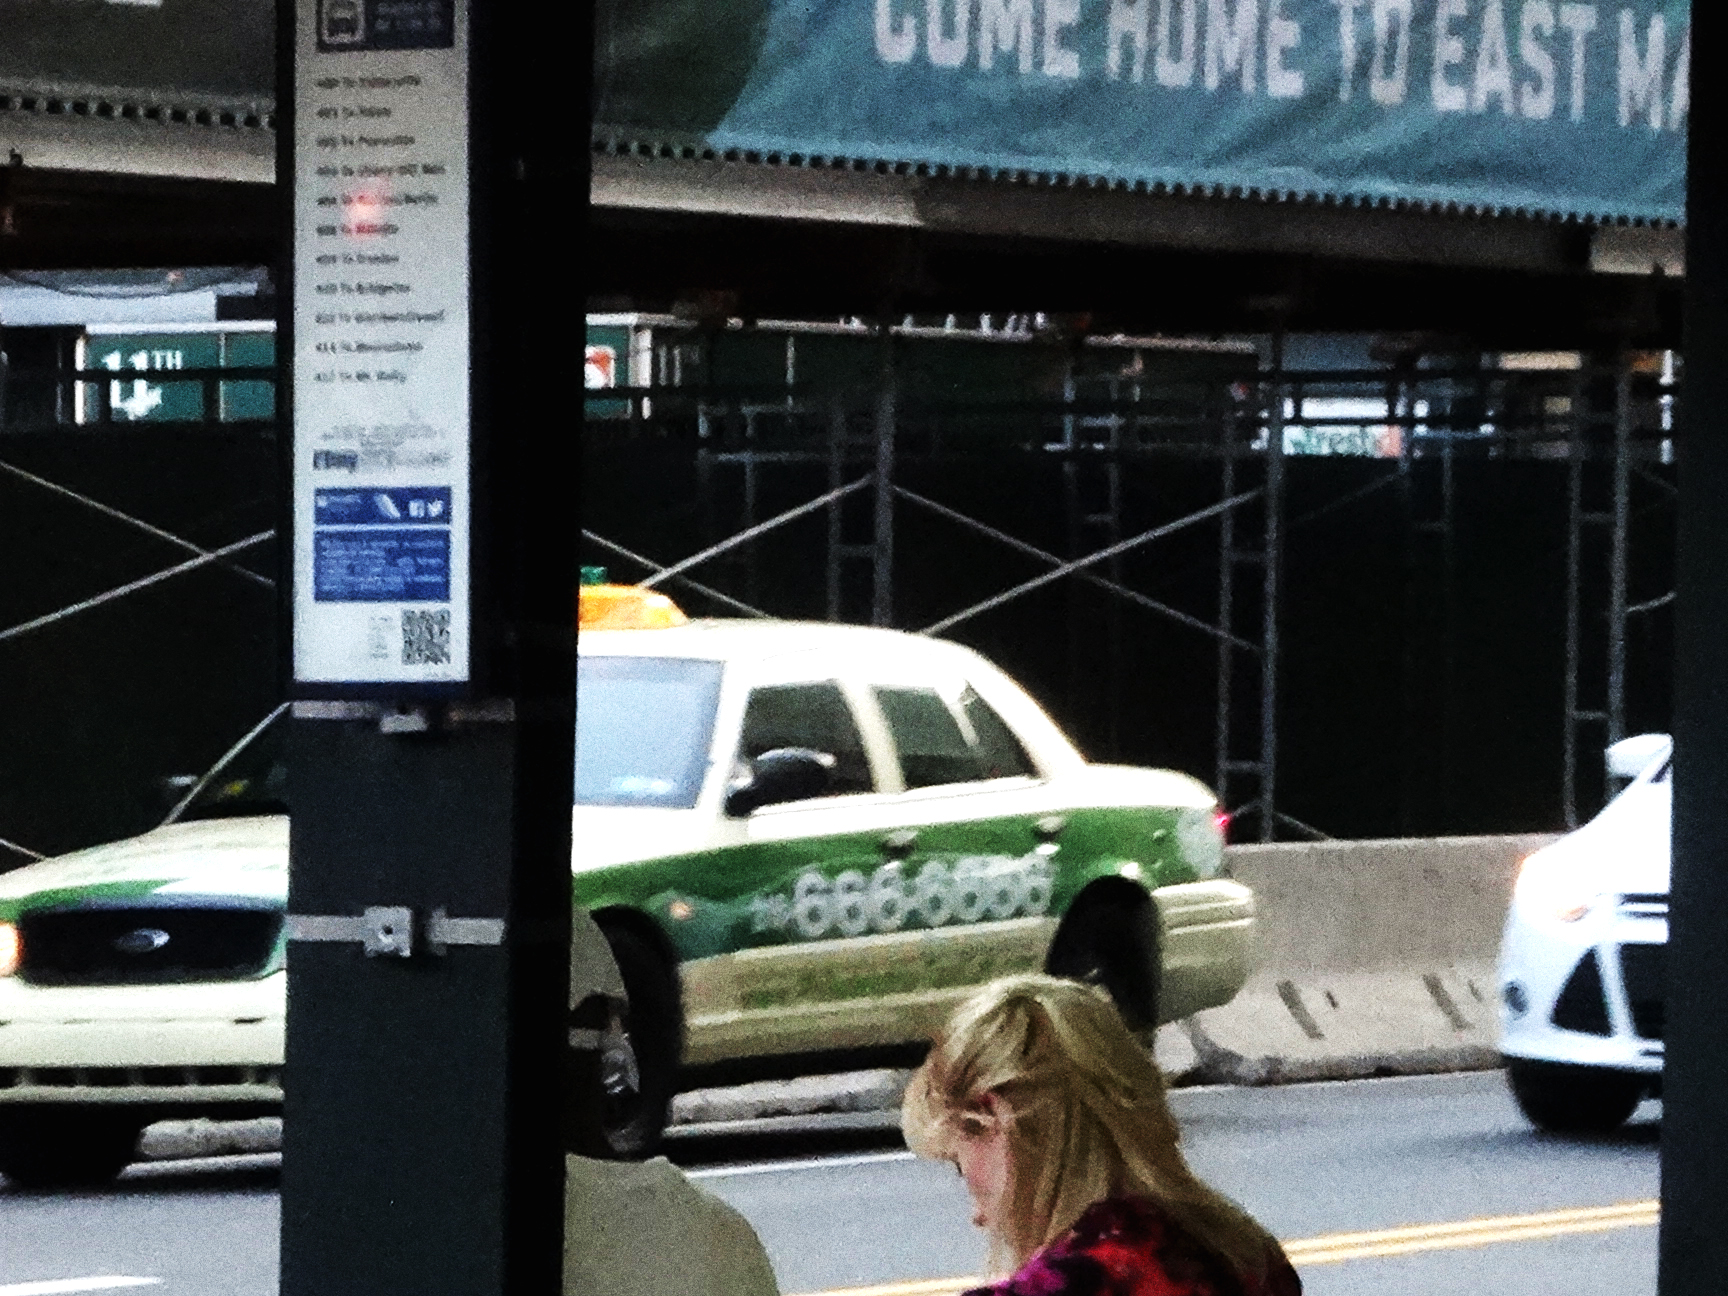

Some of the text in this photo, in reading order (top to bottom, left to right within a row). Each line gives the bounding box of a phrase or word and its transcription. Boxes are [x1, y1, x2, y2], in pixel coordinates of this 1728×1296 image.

[875, 0, 1081, 79] COME
[1107, 0, 1305, 98] HOME
[1431, 0, 1598, 124] EAST
